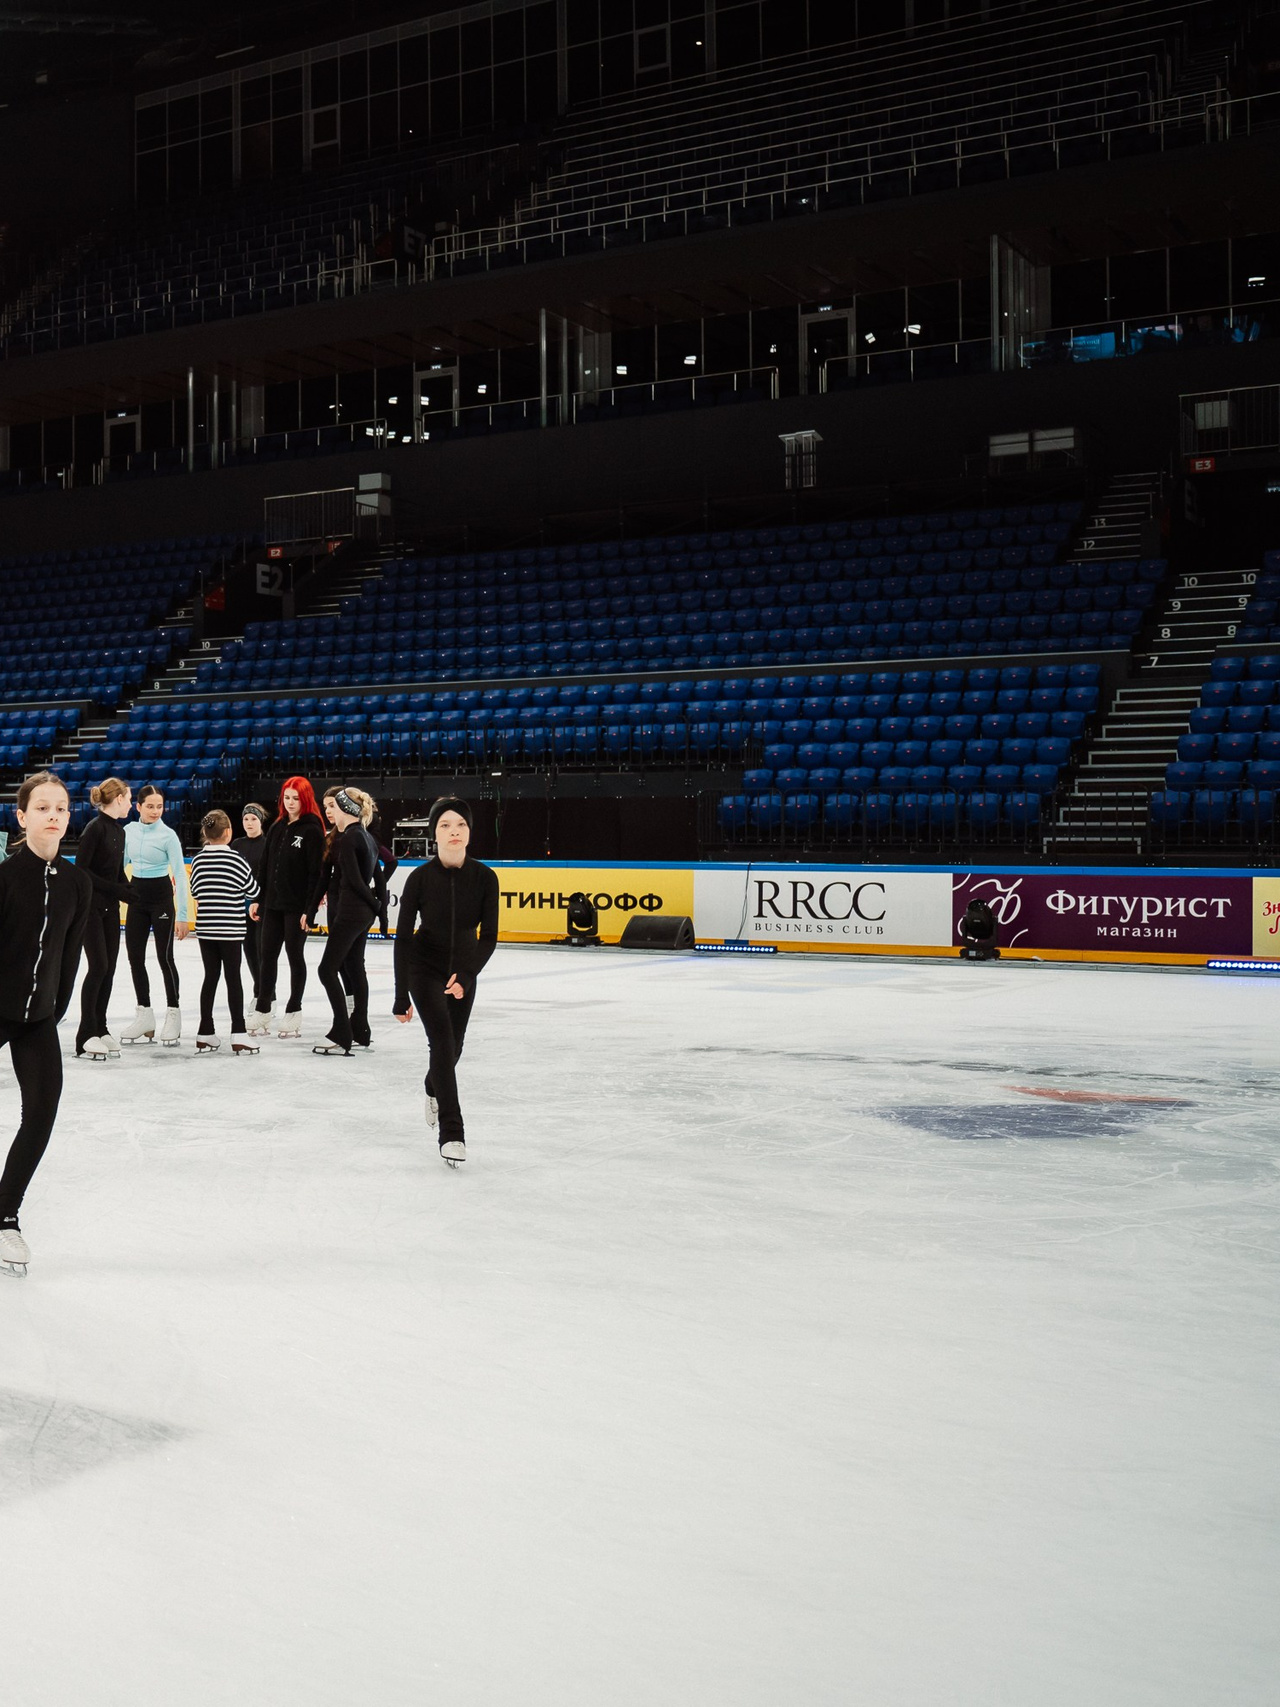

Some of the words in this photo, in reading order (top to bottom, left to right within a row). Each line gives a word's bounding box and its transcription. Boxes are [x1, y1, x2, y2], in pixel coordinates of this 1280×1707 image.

[1195, 460, 1212, 471] E3
[1094, 518, 1106, 528] 13
[1082, 540, 1096, 550] 12
[270, 549, 281, 557] E2
[256, 563, 284, 597] E2
[1183, 577, 1199, 587] 10
[1241, 573, 1257, 583] 10
[1172, 601, 1182, 611] 9
[1238, 597, 1248, 608] 9
[1161, 627, 1171, 638] 8
[1227, 625, 1237, 636] 8
[201, 641, 211, 650] 10
[1149, 656, 1159, 667] 7
[500, 892, 663, 912] ТИНЬОФФ
[753, 880, 886, 922] RRCC
[1045, 888, 1232, 923] Фигурист
[754, 923, 835, 934] BUSINESS
[841, 925, 884, 936] CLUB
[1096, 926, 1178, 939] магазин
